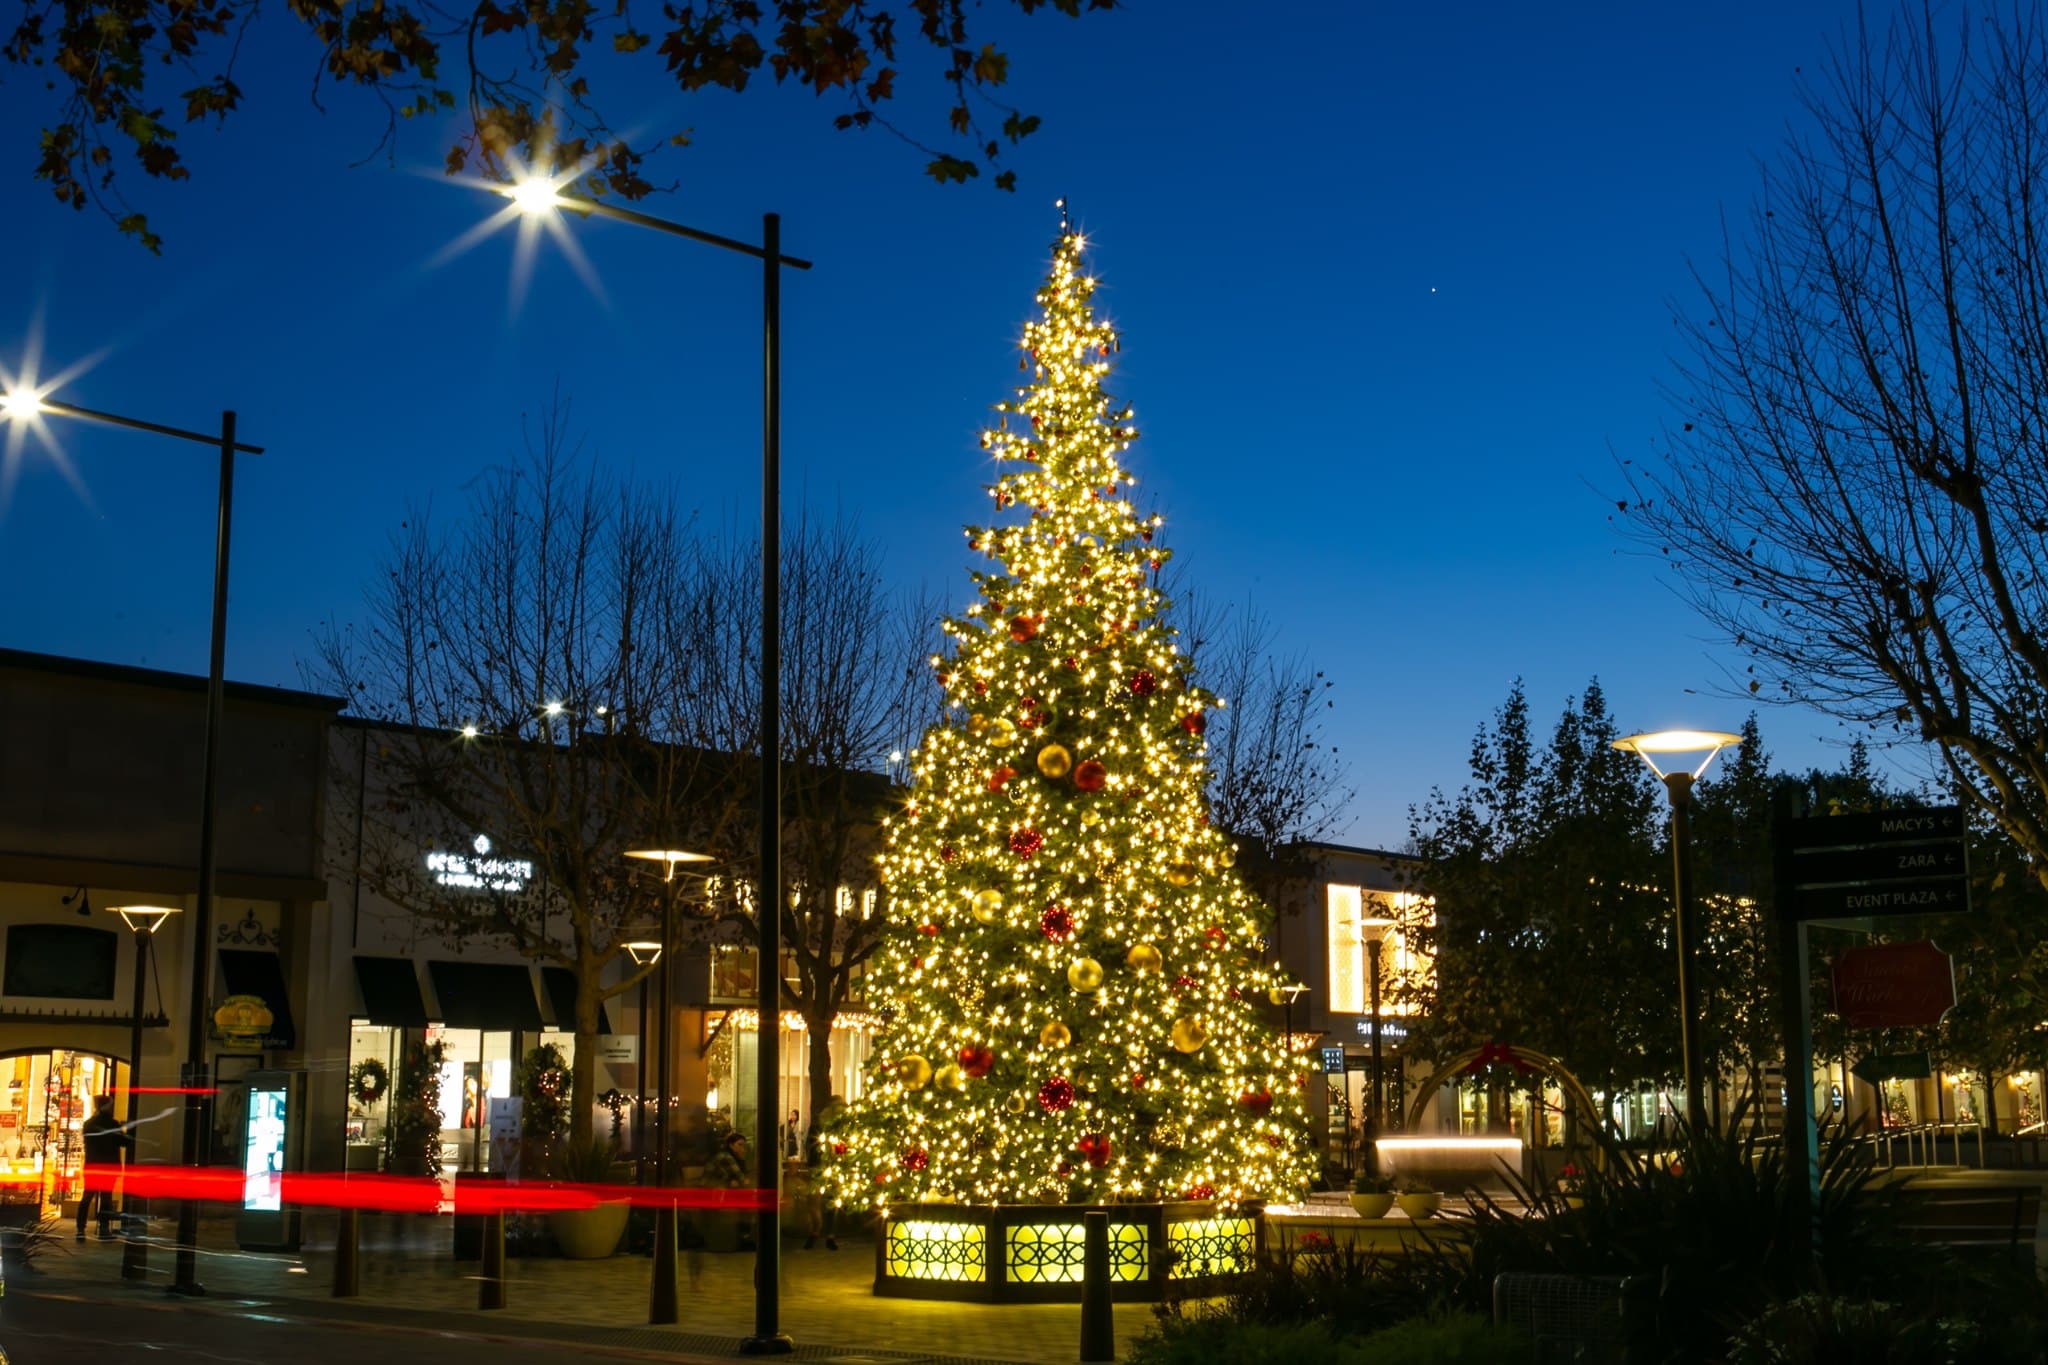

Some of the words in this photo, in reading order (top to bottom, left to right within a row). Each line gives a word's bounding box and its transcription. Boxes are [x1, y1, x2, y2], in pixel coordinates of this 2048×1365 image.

[1881, 817, 1935, 833] MACY'S
[1898, 855, 1936, 869] ZARA
[1846, 893, 1889, 908] EVENT
[1893, 891, 1938, 906] PLAZA
